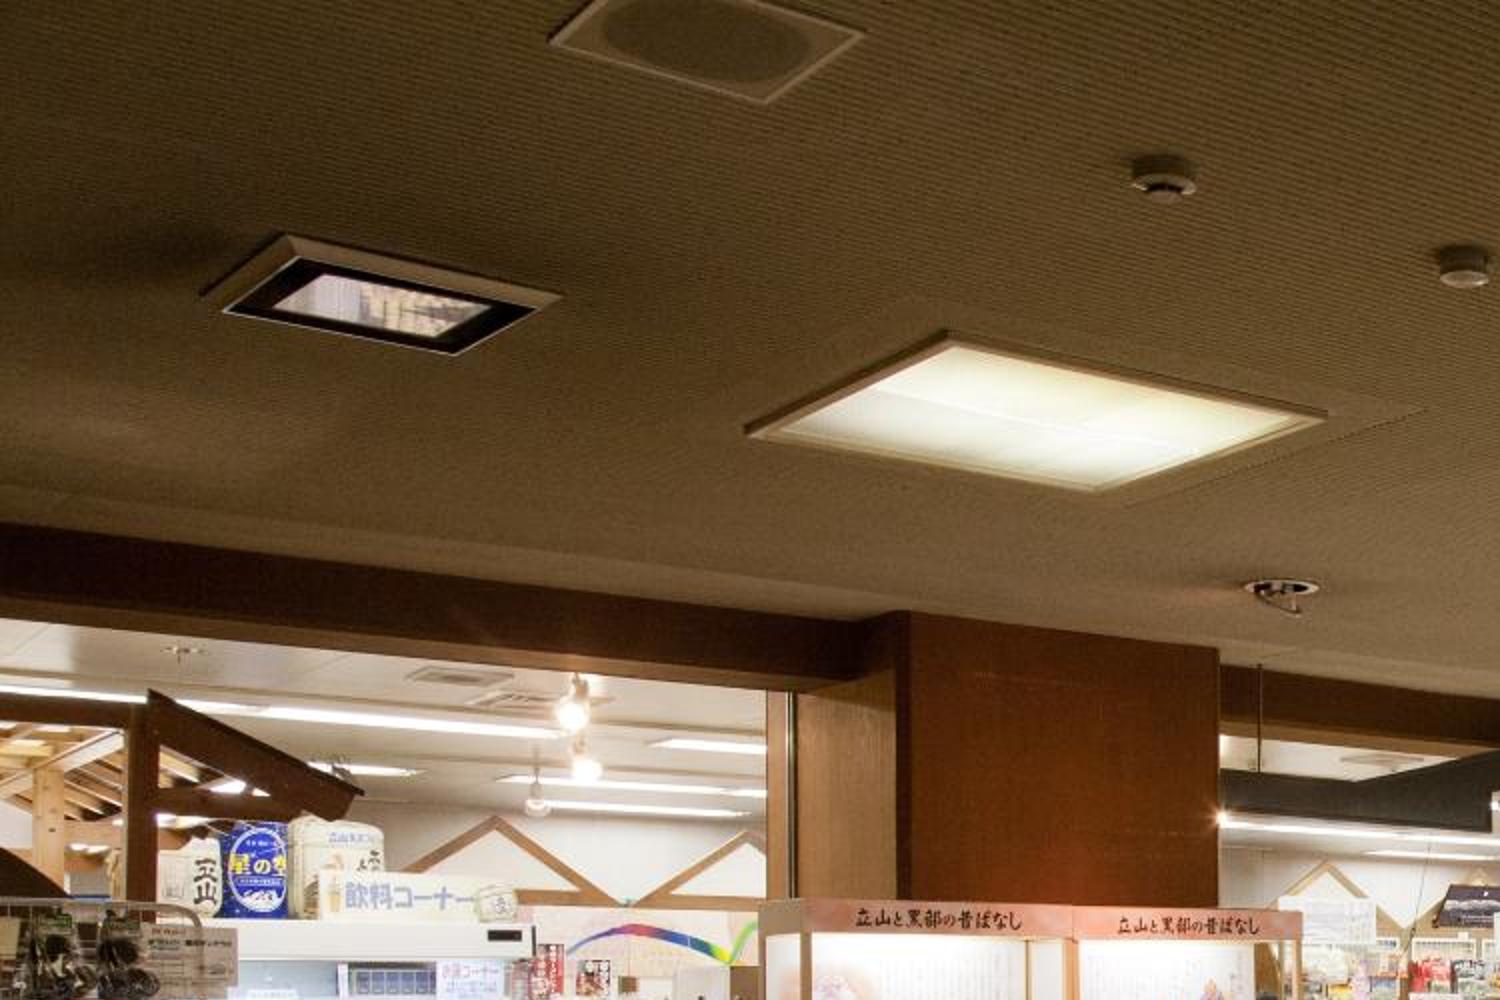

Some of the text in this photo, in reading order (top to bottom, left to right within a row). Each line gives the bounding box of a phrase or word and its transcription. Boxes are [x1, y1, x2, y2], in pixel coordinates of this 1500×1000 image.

[345, 880, 476, 911] 飲料コーナー
[855, 907, 1023, 930] 立山と黒部の昔ばなし
[1117, 915, 1261, 936] 立山と黒部の昔ばなし
